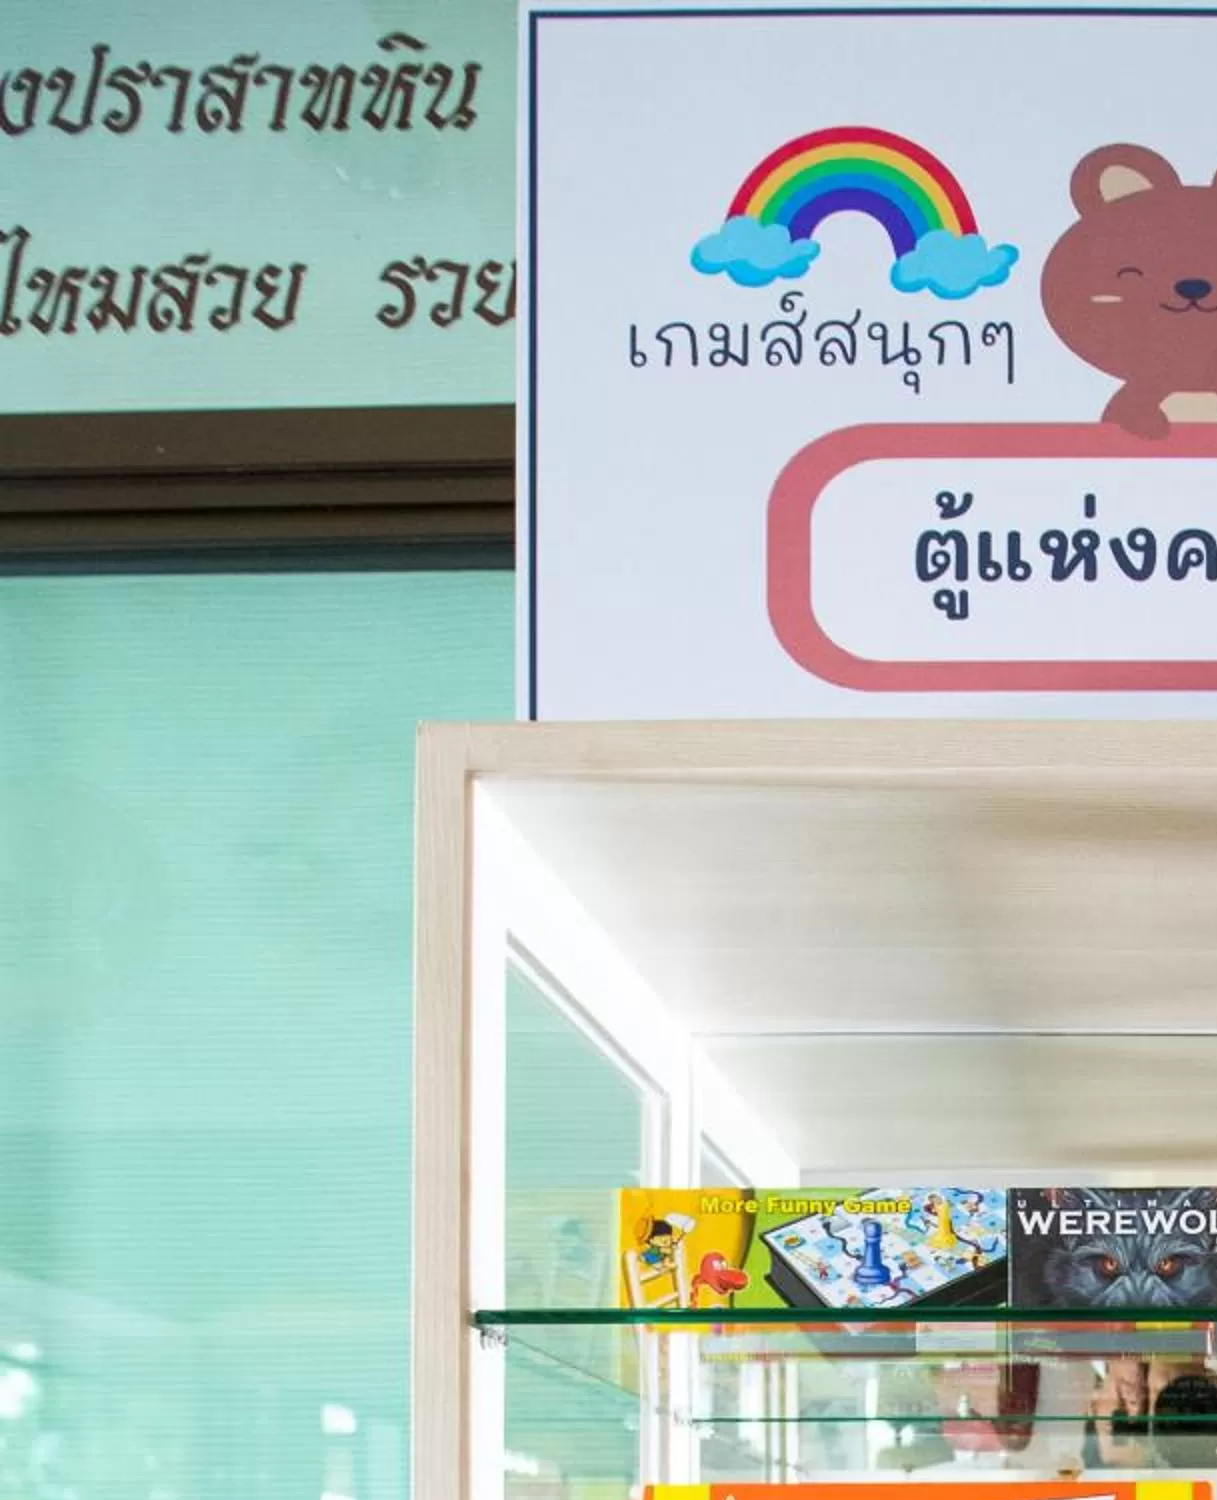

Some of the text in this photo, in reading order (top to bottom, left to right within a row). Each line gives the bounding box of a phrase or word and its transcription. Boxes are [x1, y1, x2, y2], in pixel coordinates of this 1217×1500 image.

[629, 291, 1014, 394] เกมส์สนุกๆ
[701, 1197, 911, 1216] More Funny Game
